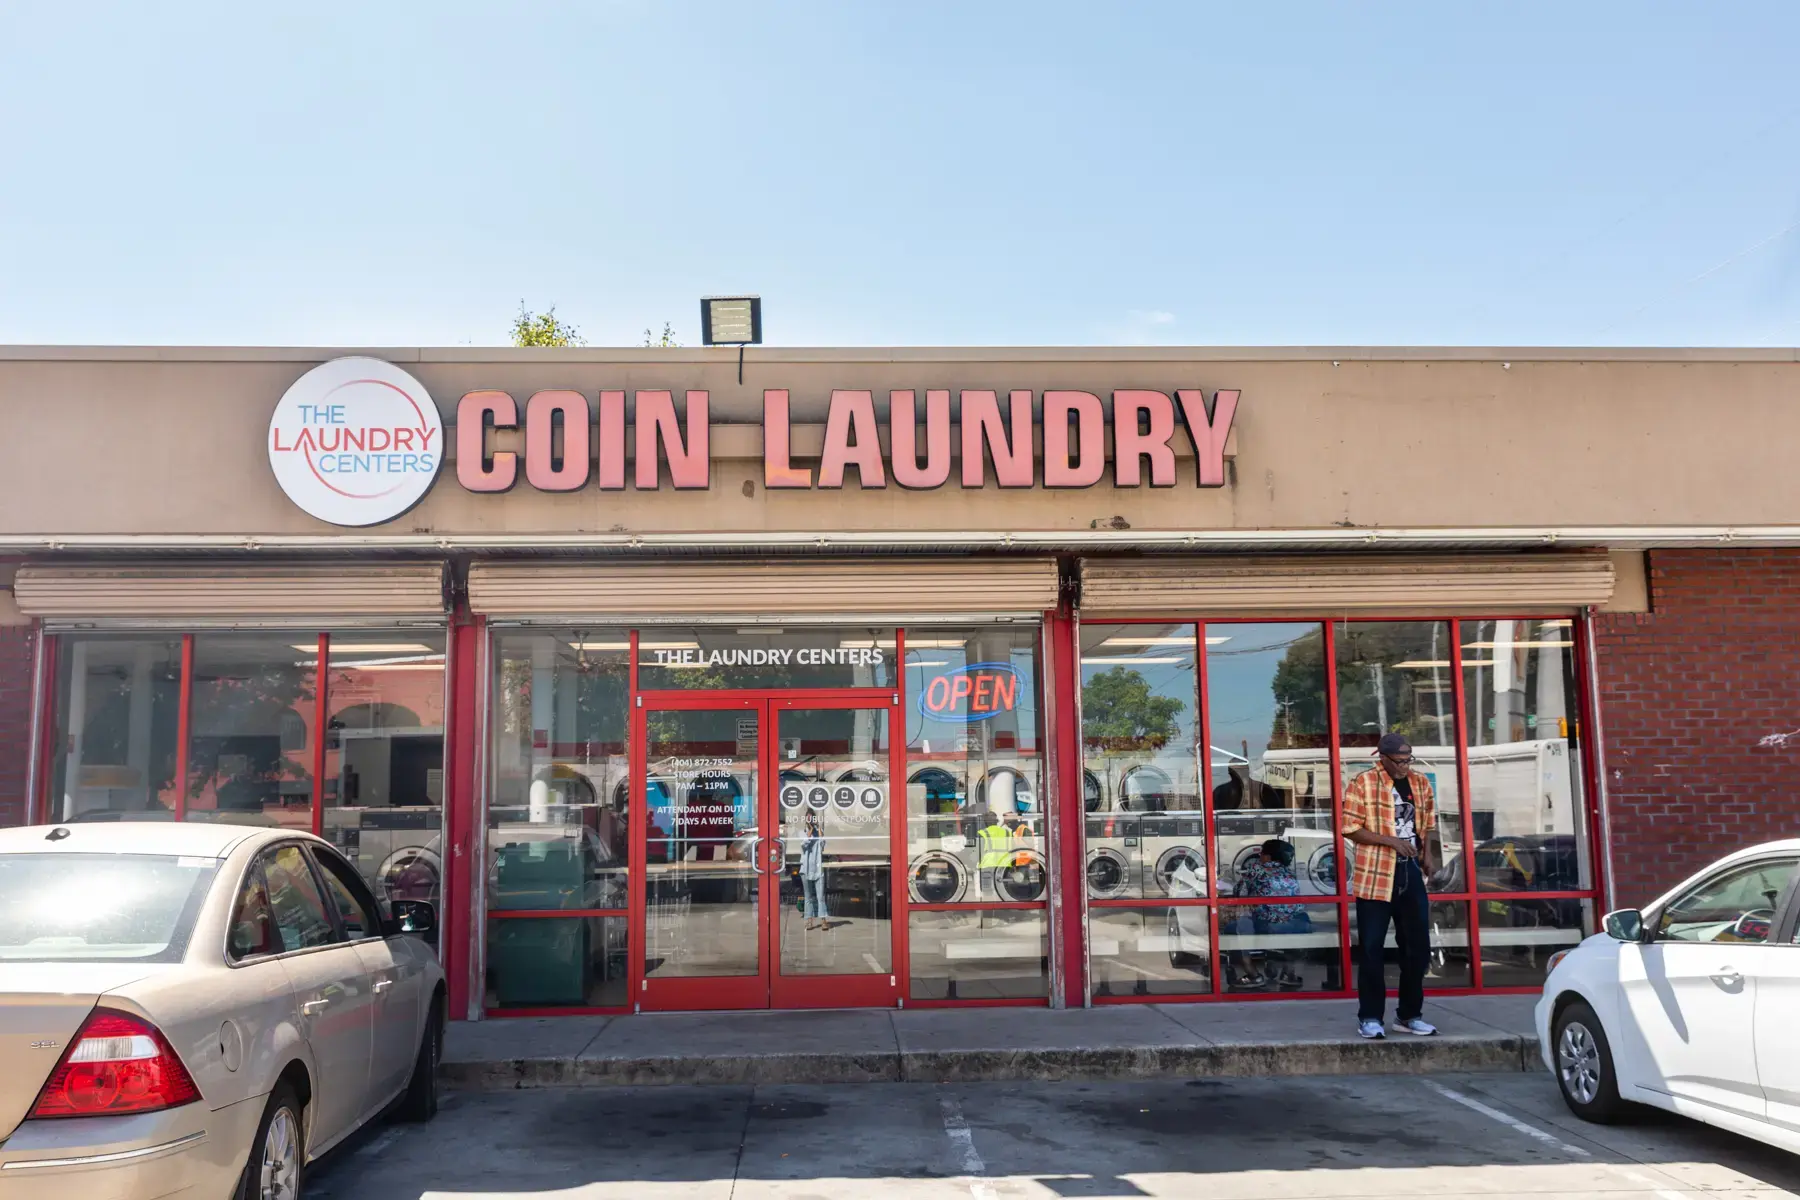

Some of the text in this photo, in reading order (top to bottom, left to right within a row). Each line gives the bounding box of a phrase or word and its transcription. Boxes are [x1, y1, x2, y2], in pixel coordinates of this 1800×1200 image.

[298, 405, 345, 423] THE
[274, 427, 436, 451] LAUNDRY
[457, 389, 1242, 493] COIN LAUNDRY
[319, 453, 434, 472] CENTERS
[654, 648, 884, 665] THE LAUNDRY CENTERS
[927, 675, 1016, 711] OPEN
[694, 758, 733, 766] 872-7552
[674, 770, 731, 778] STORE HOURS
[675, 782, 696, 790] 7AM
[657, 804, 748, 814] ATTENDANT ON DUTY
[678, 817, 699, 825] DAYS
[701, 817, 707, 825] A
[709, 816, 734, 825] WEEK
[786, 815, 799, 823] NO
